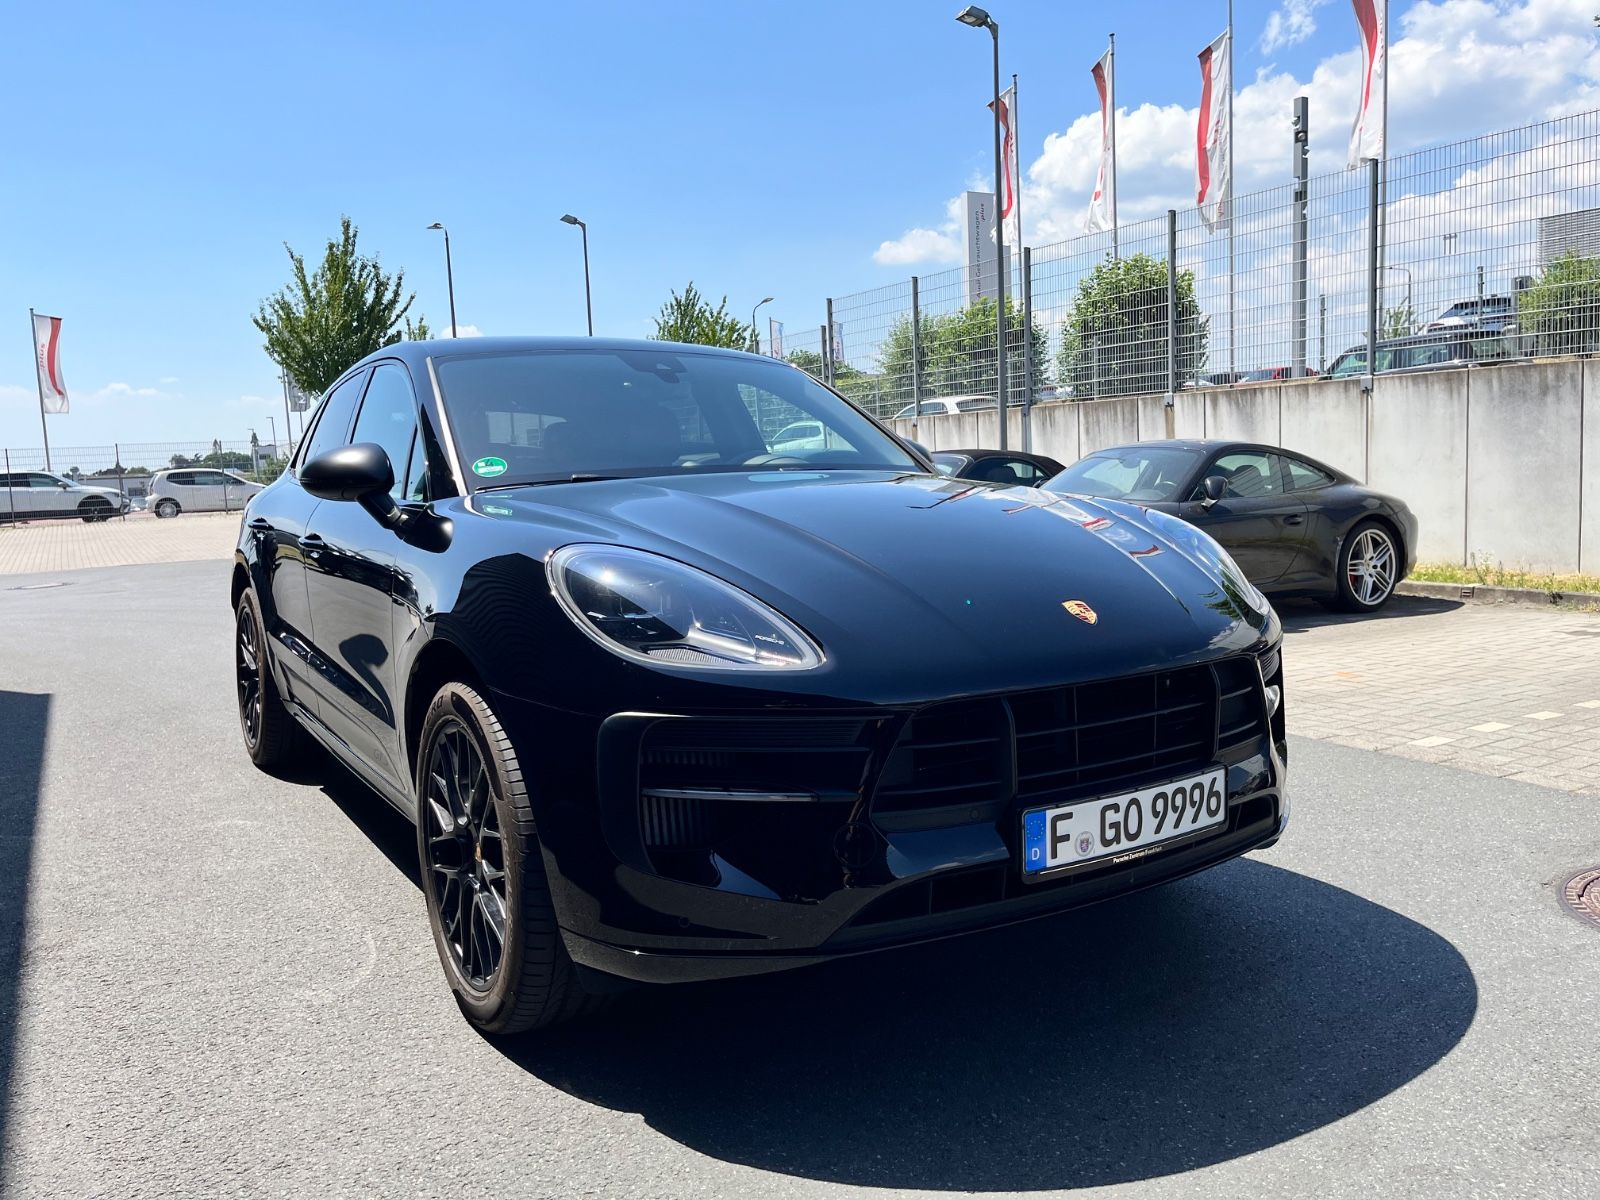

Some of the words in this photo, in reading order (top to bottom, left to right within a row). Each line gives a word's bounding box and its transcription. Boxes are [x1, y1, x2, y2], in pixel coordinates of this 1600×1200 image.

[1050, 811, 1074, 860] F
[1100, 797, 1143, 848] GO
[1151, 776, 1222, 835] 9996
[1031, 847, 1040, 861] D
